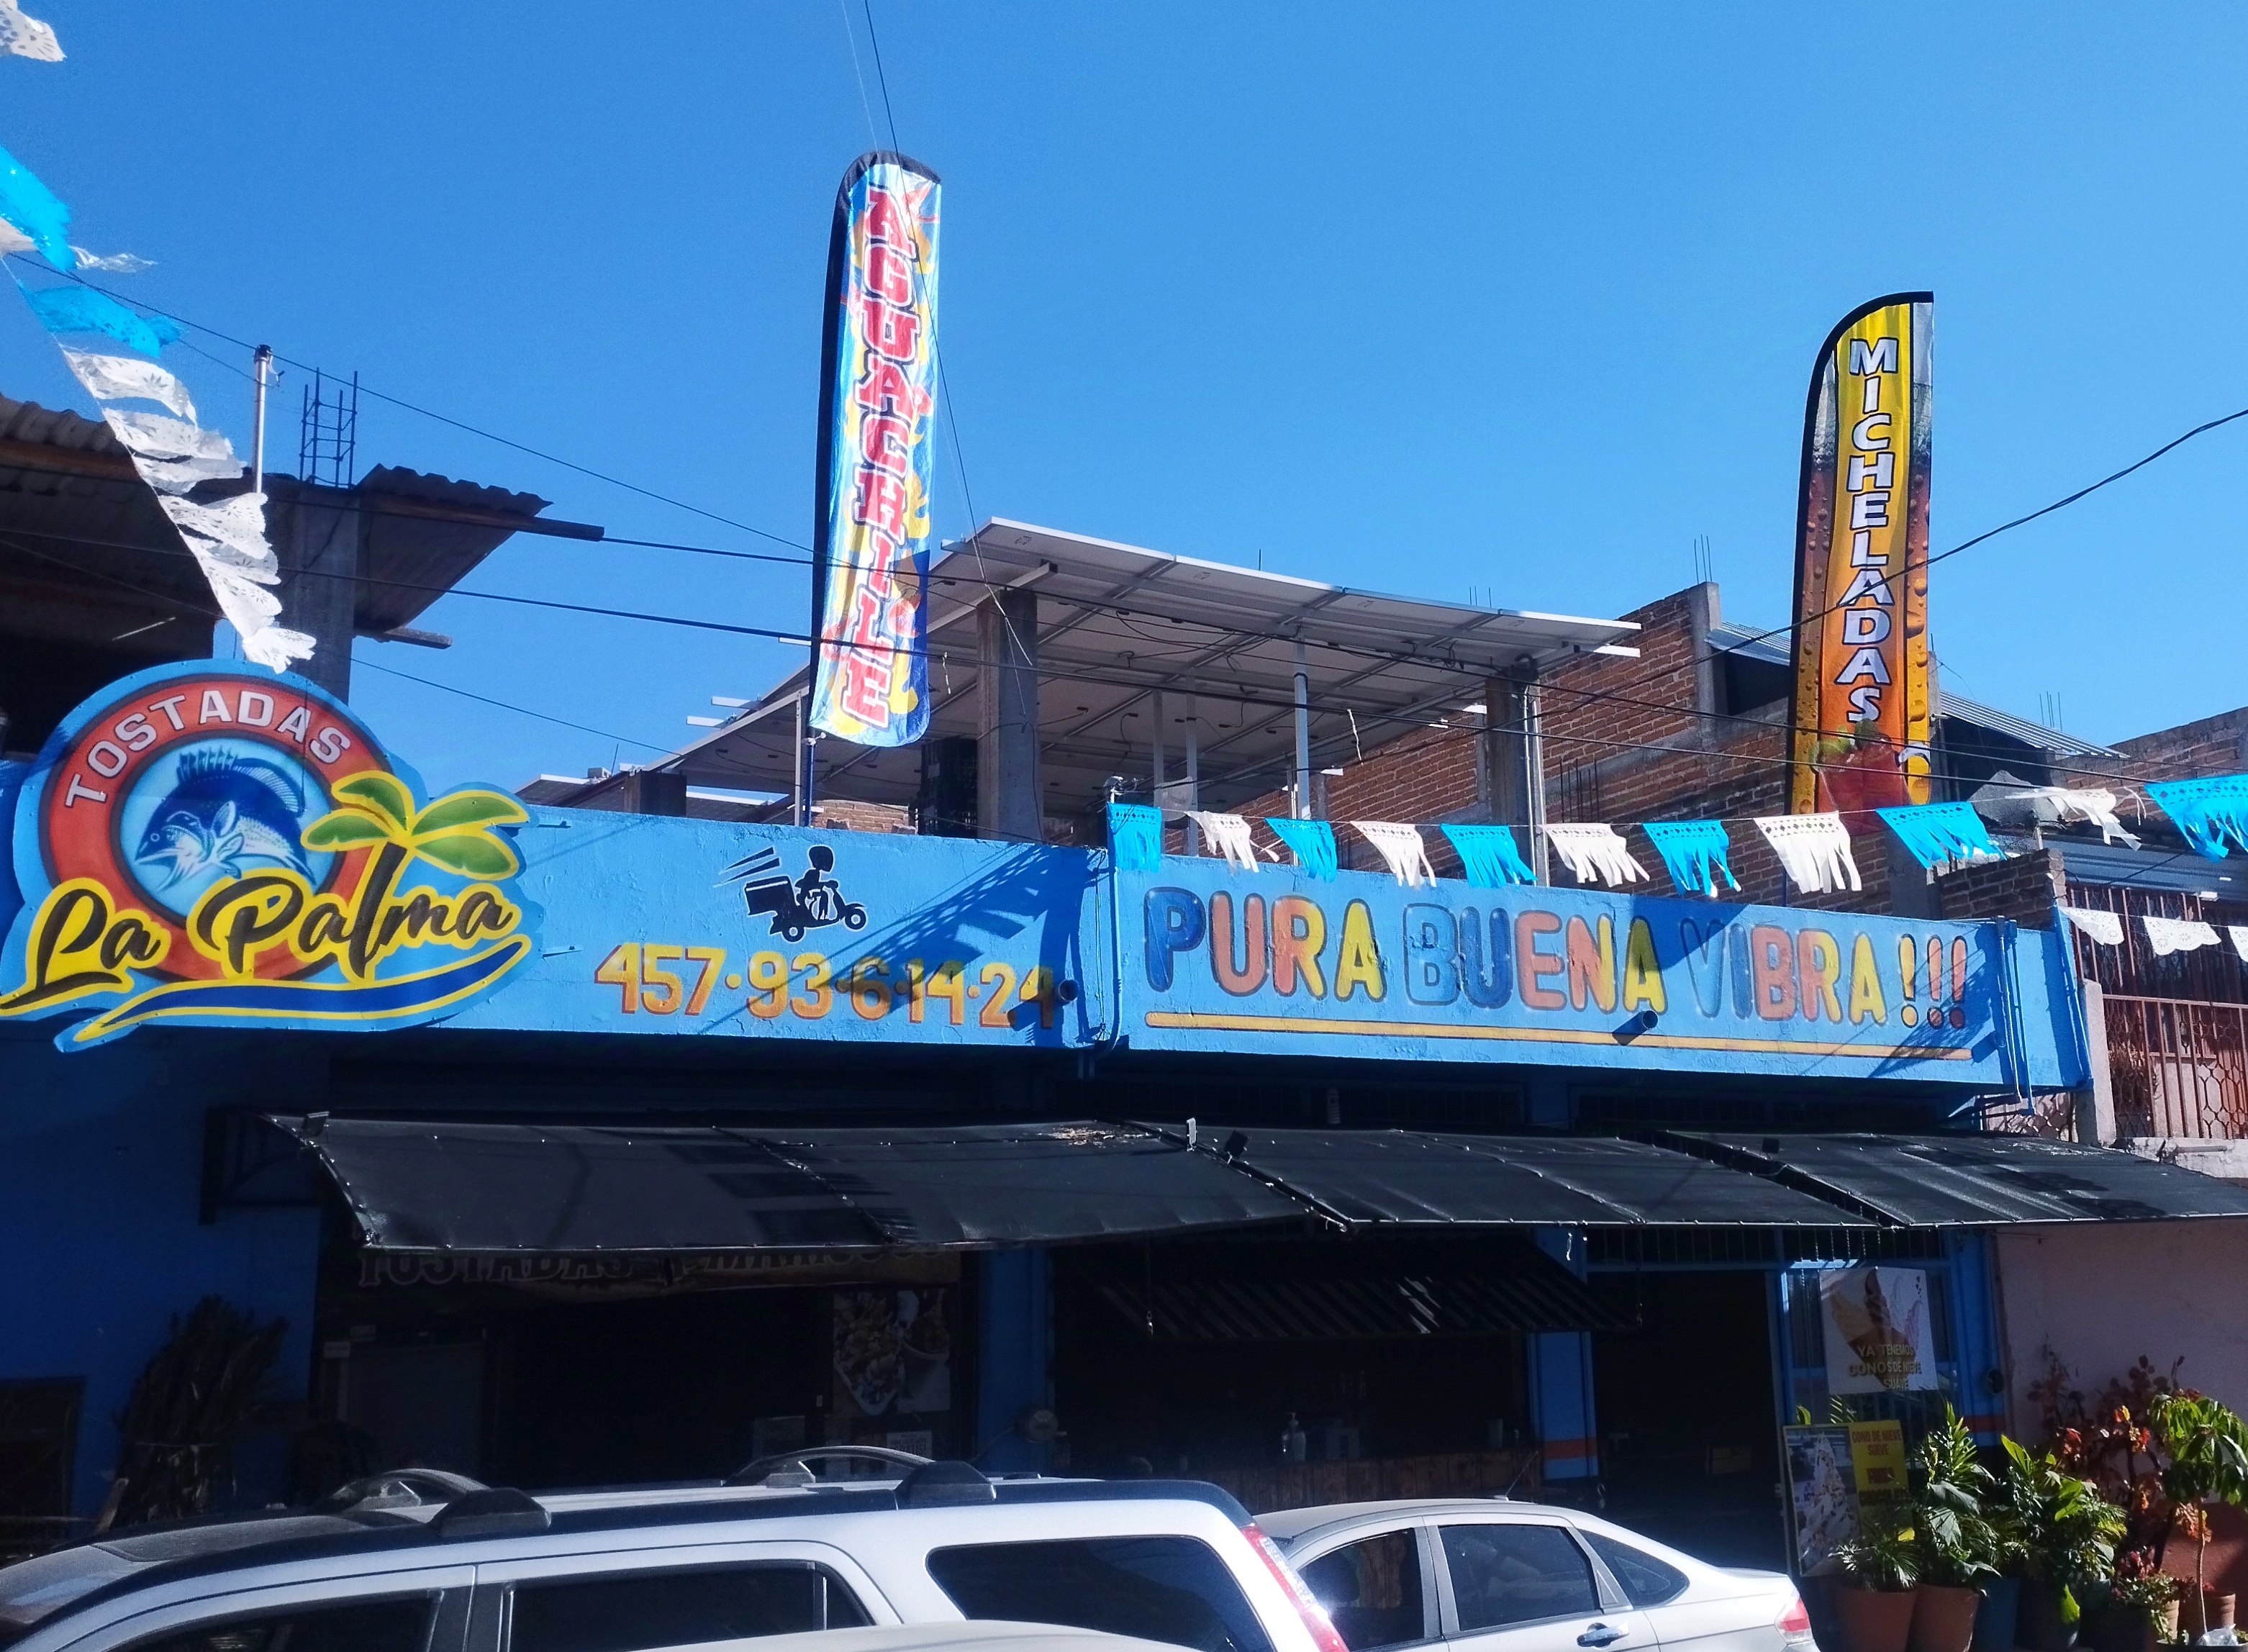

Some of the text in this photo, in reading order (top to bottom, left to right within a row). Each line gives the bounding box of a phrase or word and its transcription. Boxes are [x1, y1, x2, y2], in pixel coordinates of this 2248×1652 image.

[843, 183, 922, 730] AGUACHILE
[1834, 337, 1900, 723] MICHELADAS
[65, 689, 351, 810] TOSTADAS
[0, 843, 513, 1011] La Palma
[1143, 886, 1387, 1002] PURA
[1402, 902, 1668, 1015] BUENA
[1857, 1343, 1916, 1357] YA TENEMOS
[1883, 1379, 1910, 1391] SUAVE
[1893, 1361, 1903, 1373] DE
